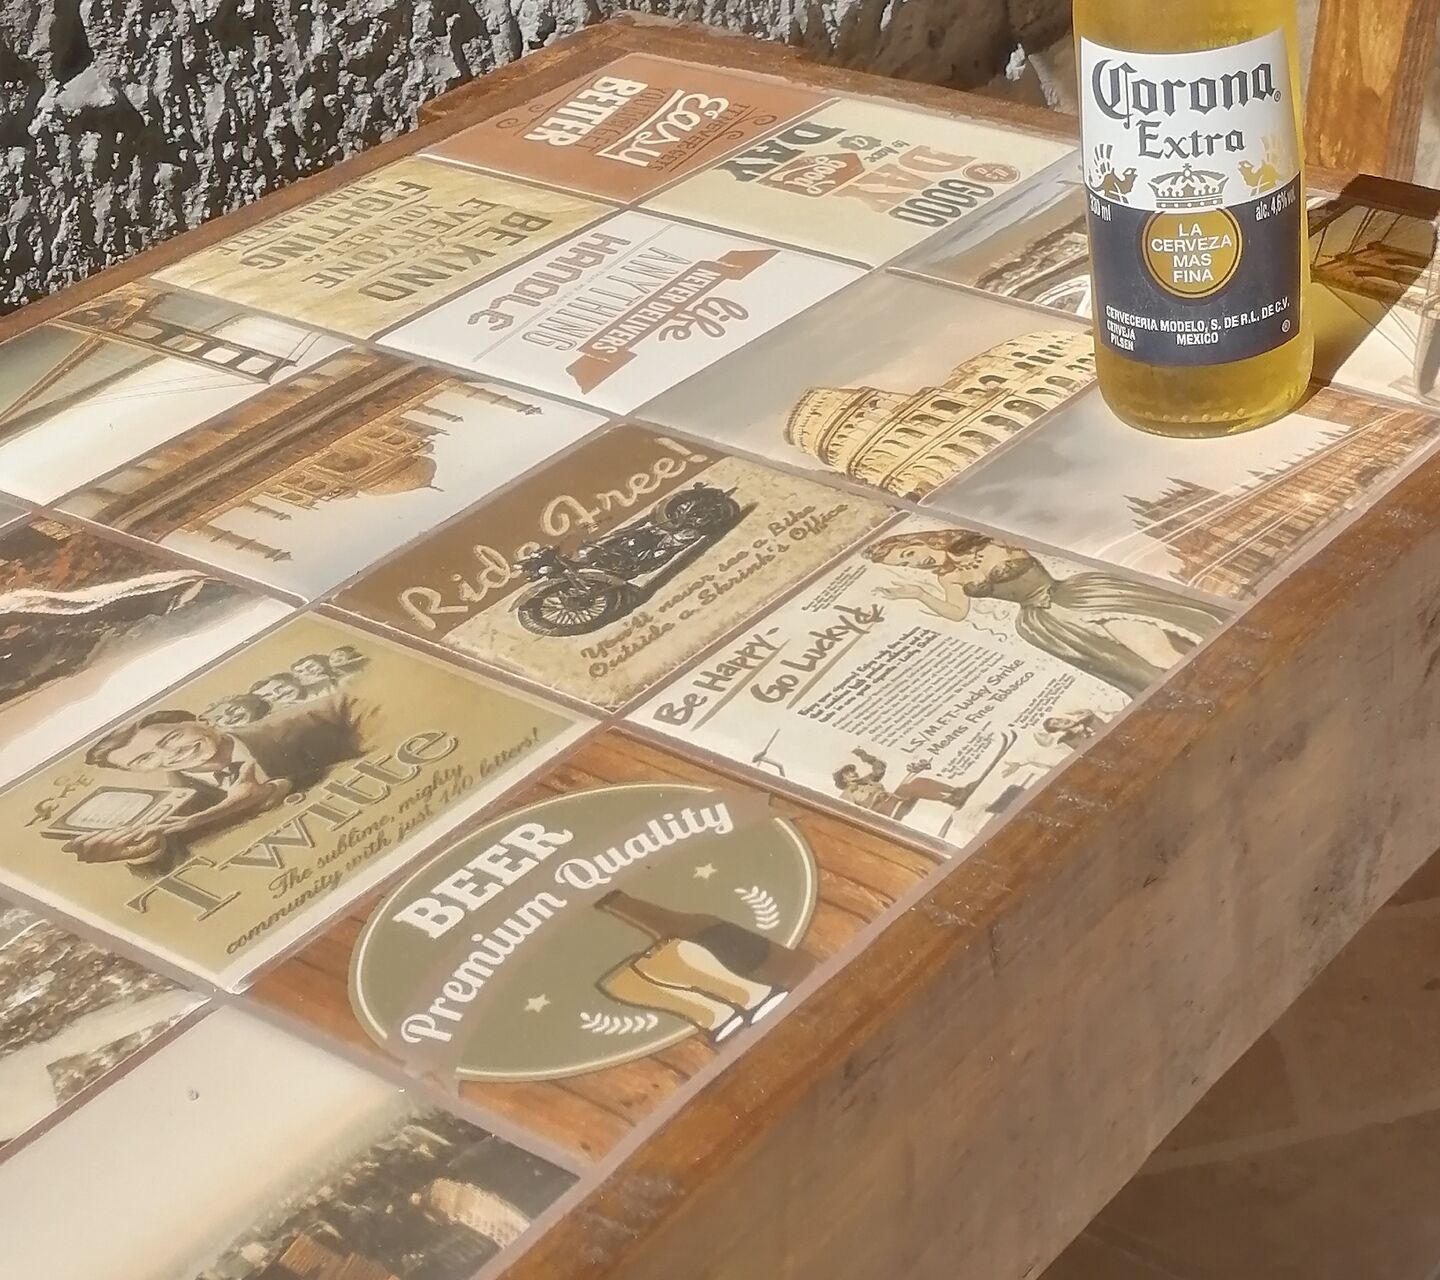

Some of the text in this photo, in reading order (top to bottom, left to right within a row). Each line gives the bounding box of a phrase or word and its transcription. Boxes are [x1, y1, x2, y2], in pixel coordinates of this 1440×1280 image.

[524, 76, 648, 145] BETTER
[1092, 59, 1275, 129] Corona
[712, 118, 846, 182] DAY
[1135, 119, 1247, 159] Extra
[770, 155, 848, 195] good
[826, 145, 977, 213] DAY
[389, 204, 443, 225] YOU
[889, 179, 994, 227] GOOD
[1255, 200, 1270, 221] alc.
[238, 181, 432, 269] FIGHTING
[301, 197, 501, 289] EVERYONE
[325, 224, 396, 256] MEET
[473, 211, 553, 246] BE
[1151, 234, 1232, 253] CERVEZA
[1178, 223, 1203, 237] LA
[357, 243, 497, 301] KIND
[1173, 253, 1212, 268] MAS
[1173, 268, 1214, 283] FINA
[467, 232, 631, 331] HANDLE
[521, 247, 692, 351] ANYTHING
[592, 268, 721, 353] NEVER DELIVERS
[1106, 305, 1158, 331] CERVECERIA
[1160, 319, 1209, 334] MODELO,
[1241, 311, 1260, 327] R.L.
[1261, 305, 1274, 318] DE
[1275, 296, 1290, 313] C.V.
[1106, 318, 1136, 341] CERVEJA
[1110, 333, 1135, 352] PILSEN
[400, 438, 708, 631] Ride Free!
[750, 674, 799, 703] Go
[987, 659, 1024, 686] Strike
[652, 693, 708, 727] Be
[926, 725, 968, 755] Means
[965, 705, 995, 723] Fine
[268, 866, 313, 899] The
[392, 820, 574, 939] BEER
[226, 870, 343, 955] community
[400, 802, 734, 1044] Premium Quality
